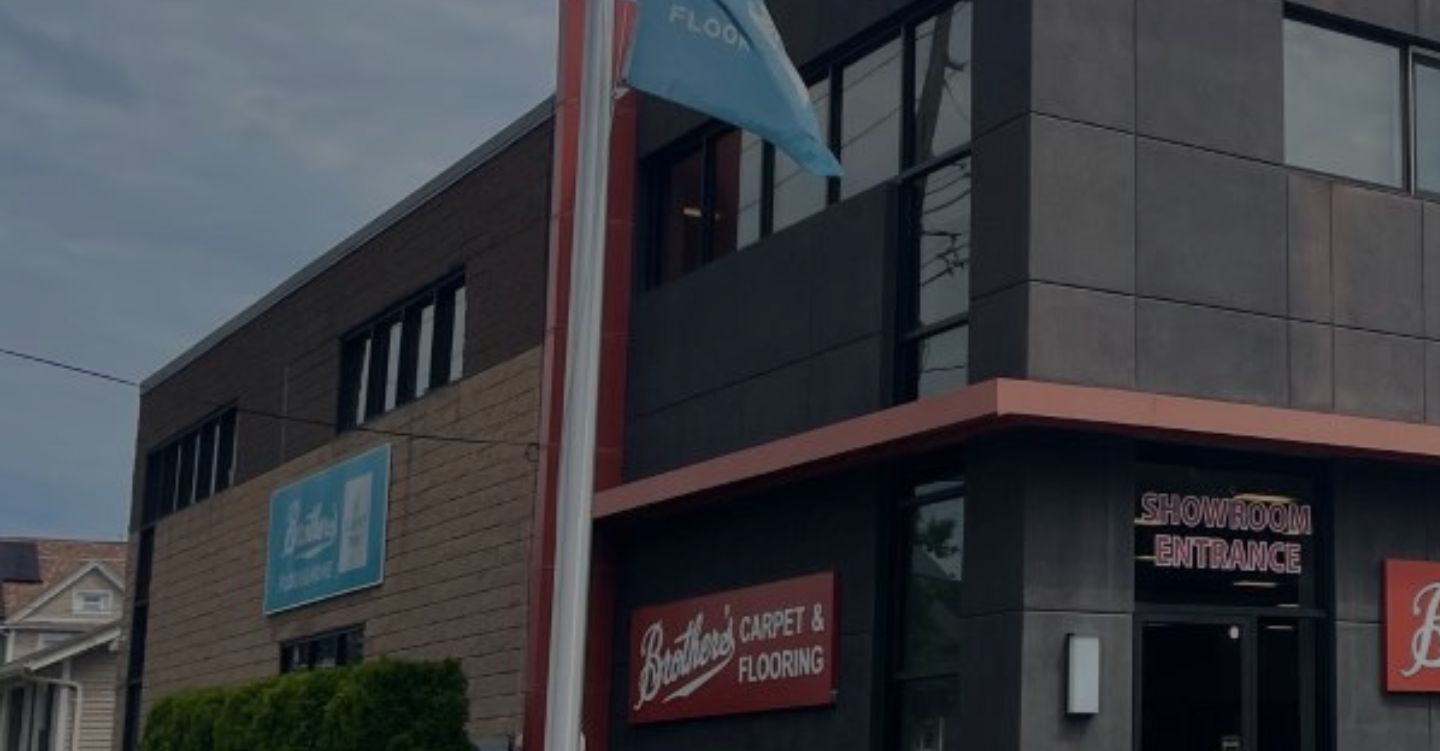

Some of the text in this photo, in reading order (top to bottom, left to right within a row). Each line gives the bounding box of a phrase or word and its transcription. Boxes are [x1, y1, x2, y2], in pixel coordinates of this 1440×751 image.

[1140, 491, 1312, 535] SHOWROOM
[1154, 533, 1302, 574] ENTRANCE
[739, 605, 806, 643] CARPET
[811, 602, 825, 632] &
[738, 645, 825, 684] FLOORING
